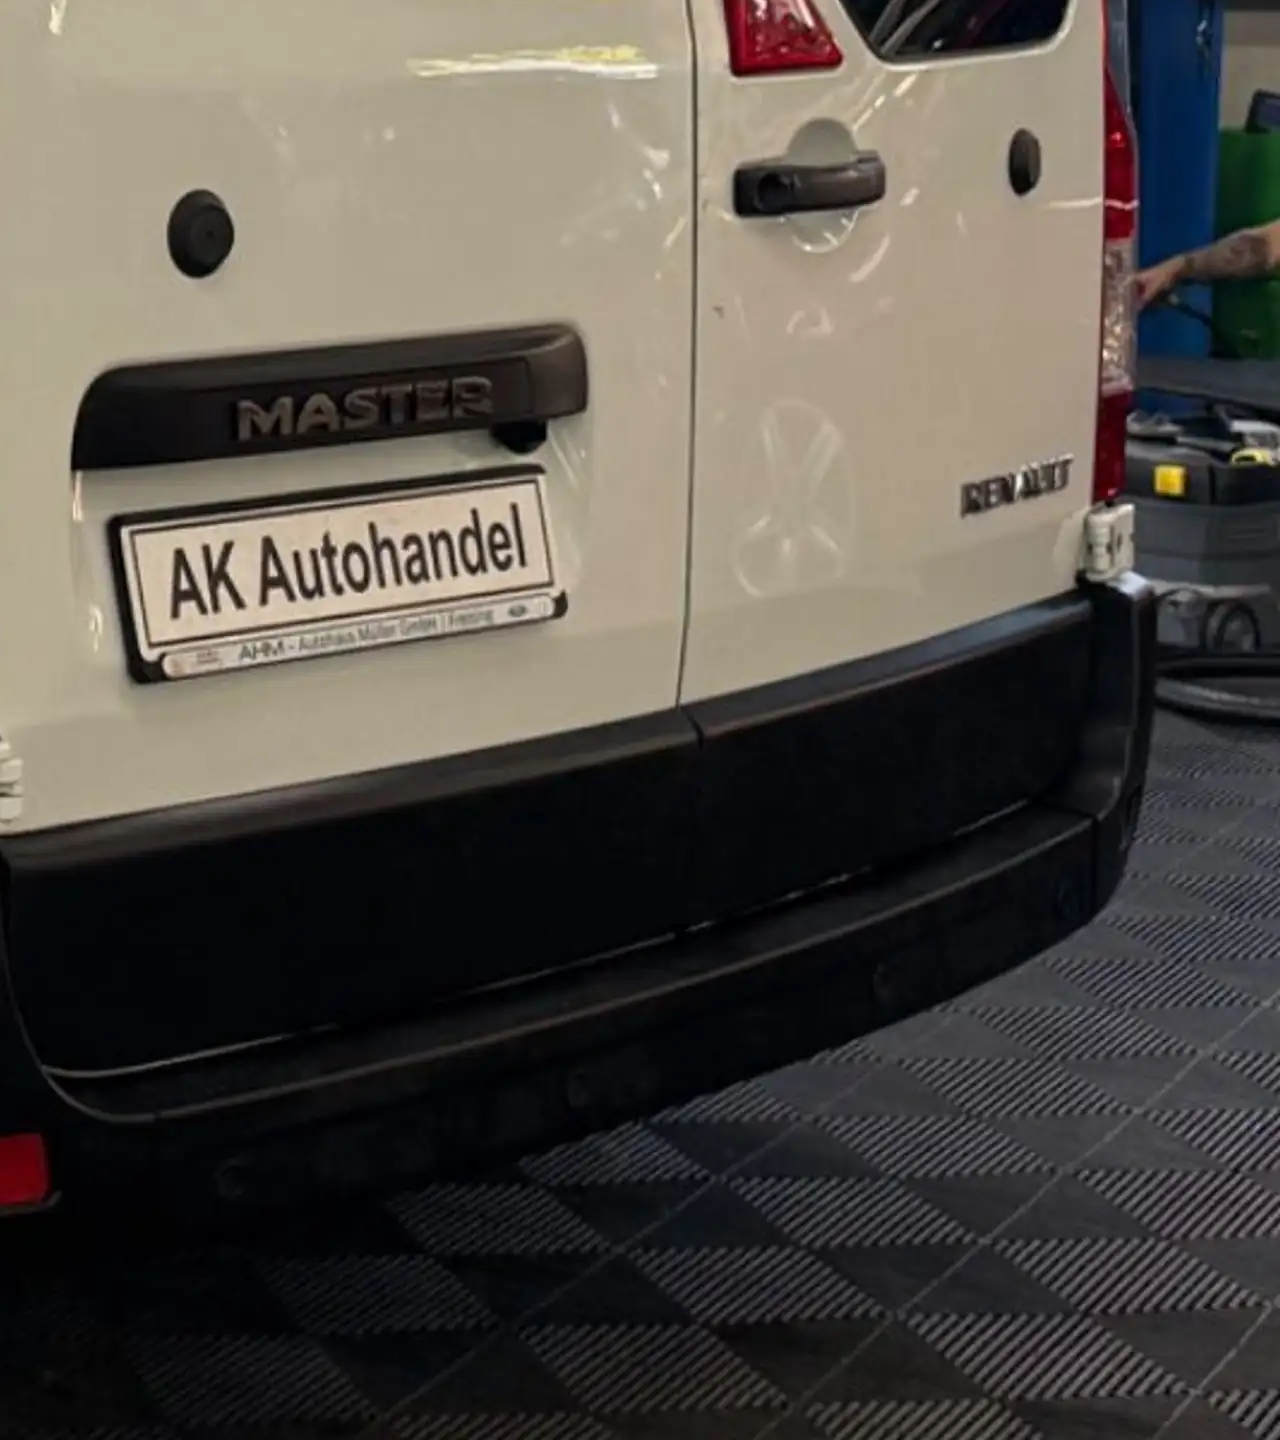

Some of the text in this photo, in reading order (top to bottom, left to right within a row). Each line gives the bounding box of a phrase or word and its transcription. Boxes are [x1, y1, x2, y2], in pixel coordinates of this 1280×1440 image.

[237, 376, 493, 441] MASTER
[960, 453, 1075, 519] RENAULT
[170, 502, 528, 620] AK Autohandel
[240, 640, 285, 660] AHM
